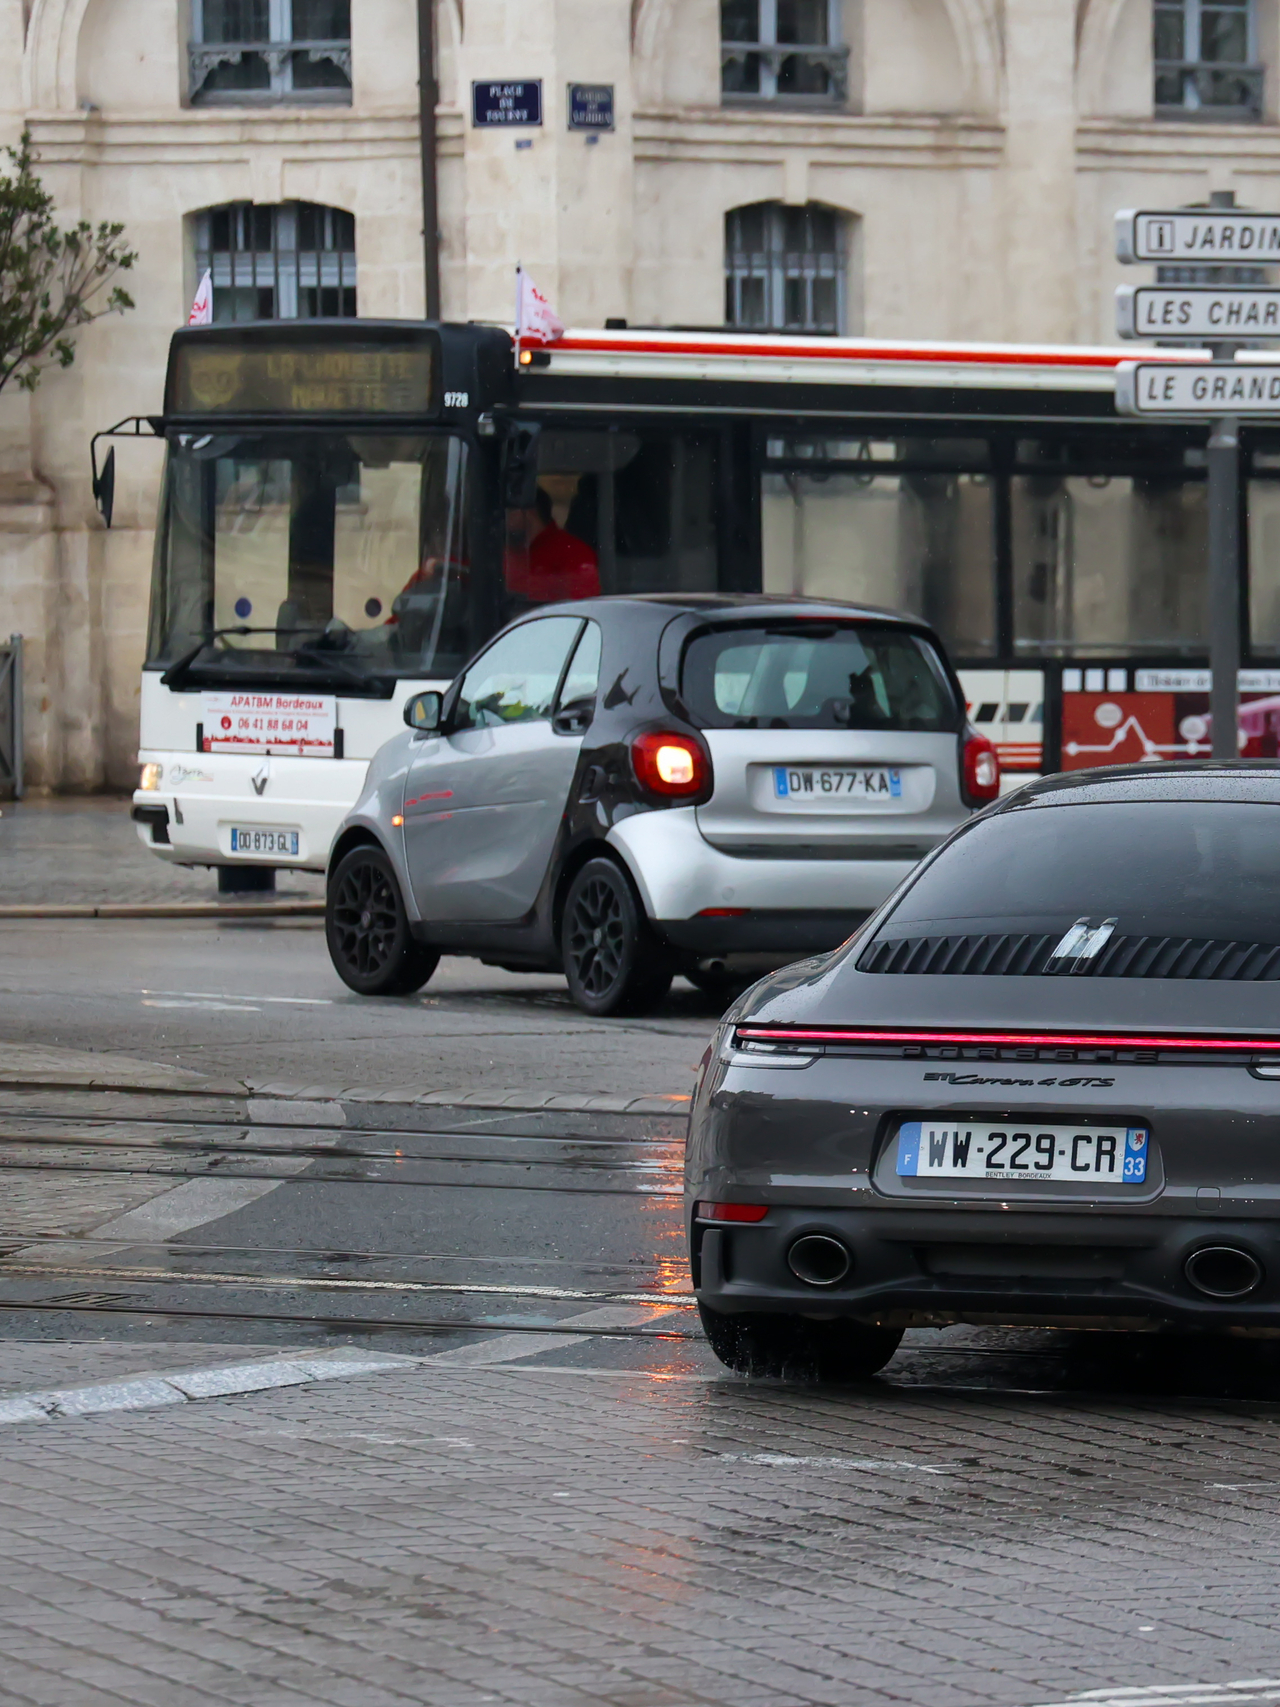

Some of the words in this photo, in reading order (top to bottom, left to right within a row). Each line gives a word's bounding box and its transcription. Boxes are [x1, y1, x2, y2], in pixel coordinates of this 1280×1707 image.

[1147, 301, 1193, 325] LES
[1148, 376, 1176, 400] LE
[230, 695, 273, 709] APATBM
[276, 697, 324, 711] Bordeaux
[238, 717, 250, 730] 06
[252, 718, 264, 731] 41
[296, 719, 309, 732] 04
[788, 770, 890, 793] DW-677-KA
[950, 1073, 1035, 1087] Carrera
[1038, 1077, 1058, 1087] 4
[1058, 1077, 1116, 1088] GTS
[903, 1154, 911, 1166] F
[928, 1130, 1117, 1173] WW-229-CR
[1123, 1156, 1145, 1176] 33
[1017, 1172, 1052, 1180] BORDEAUX
